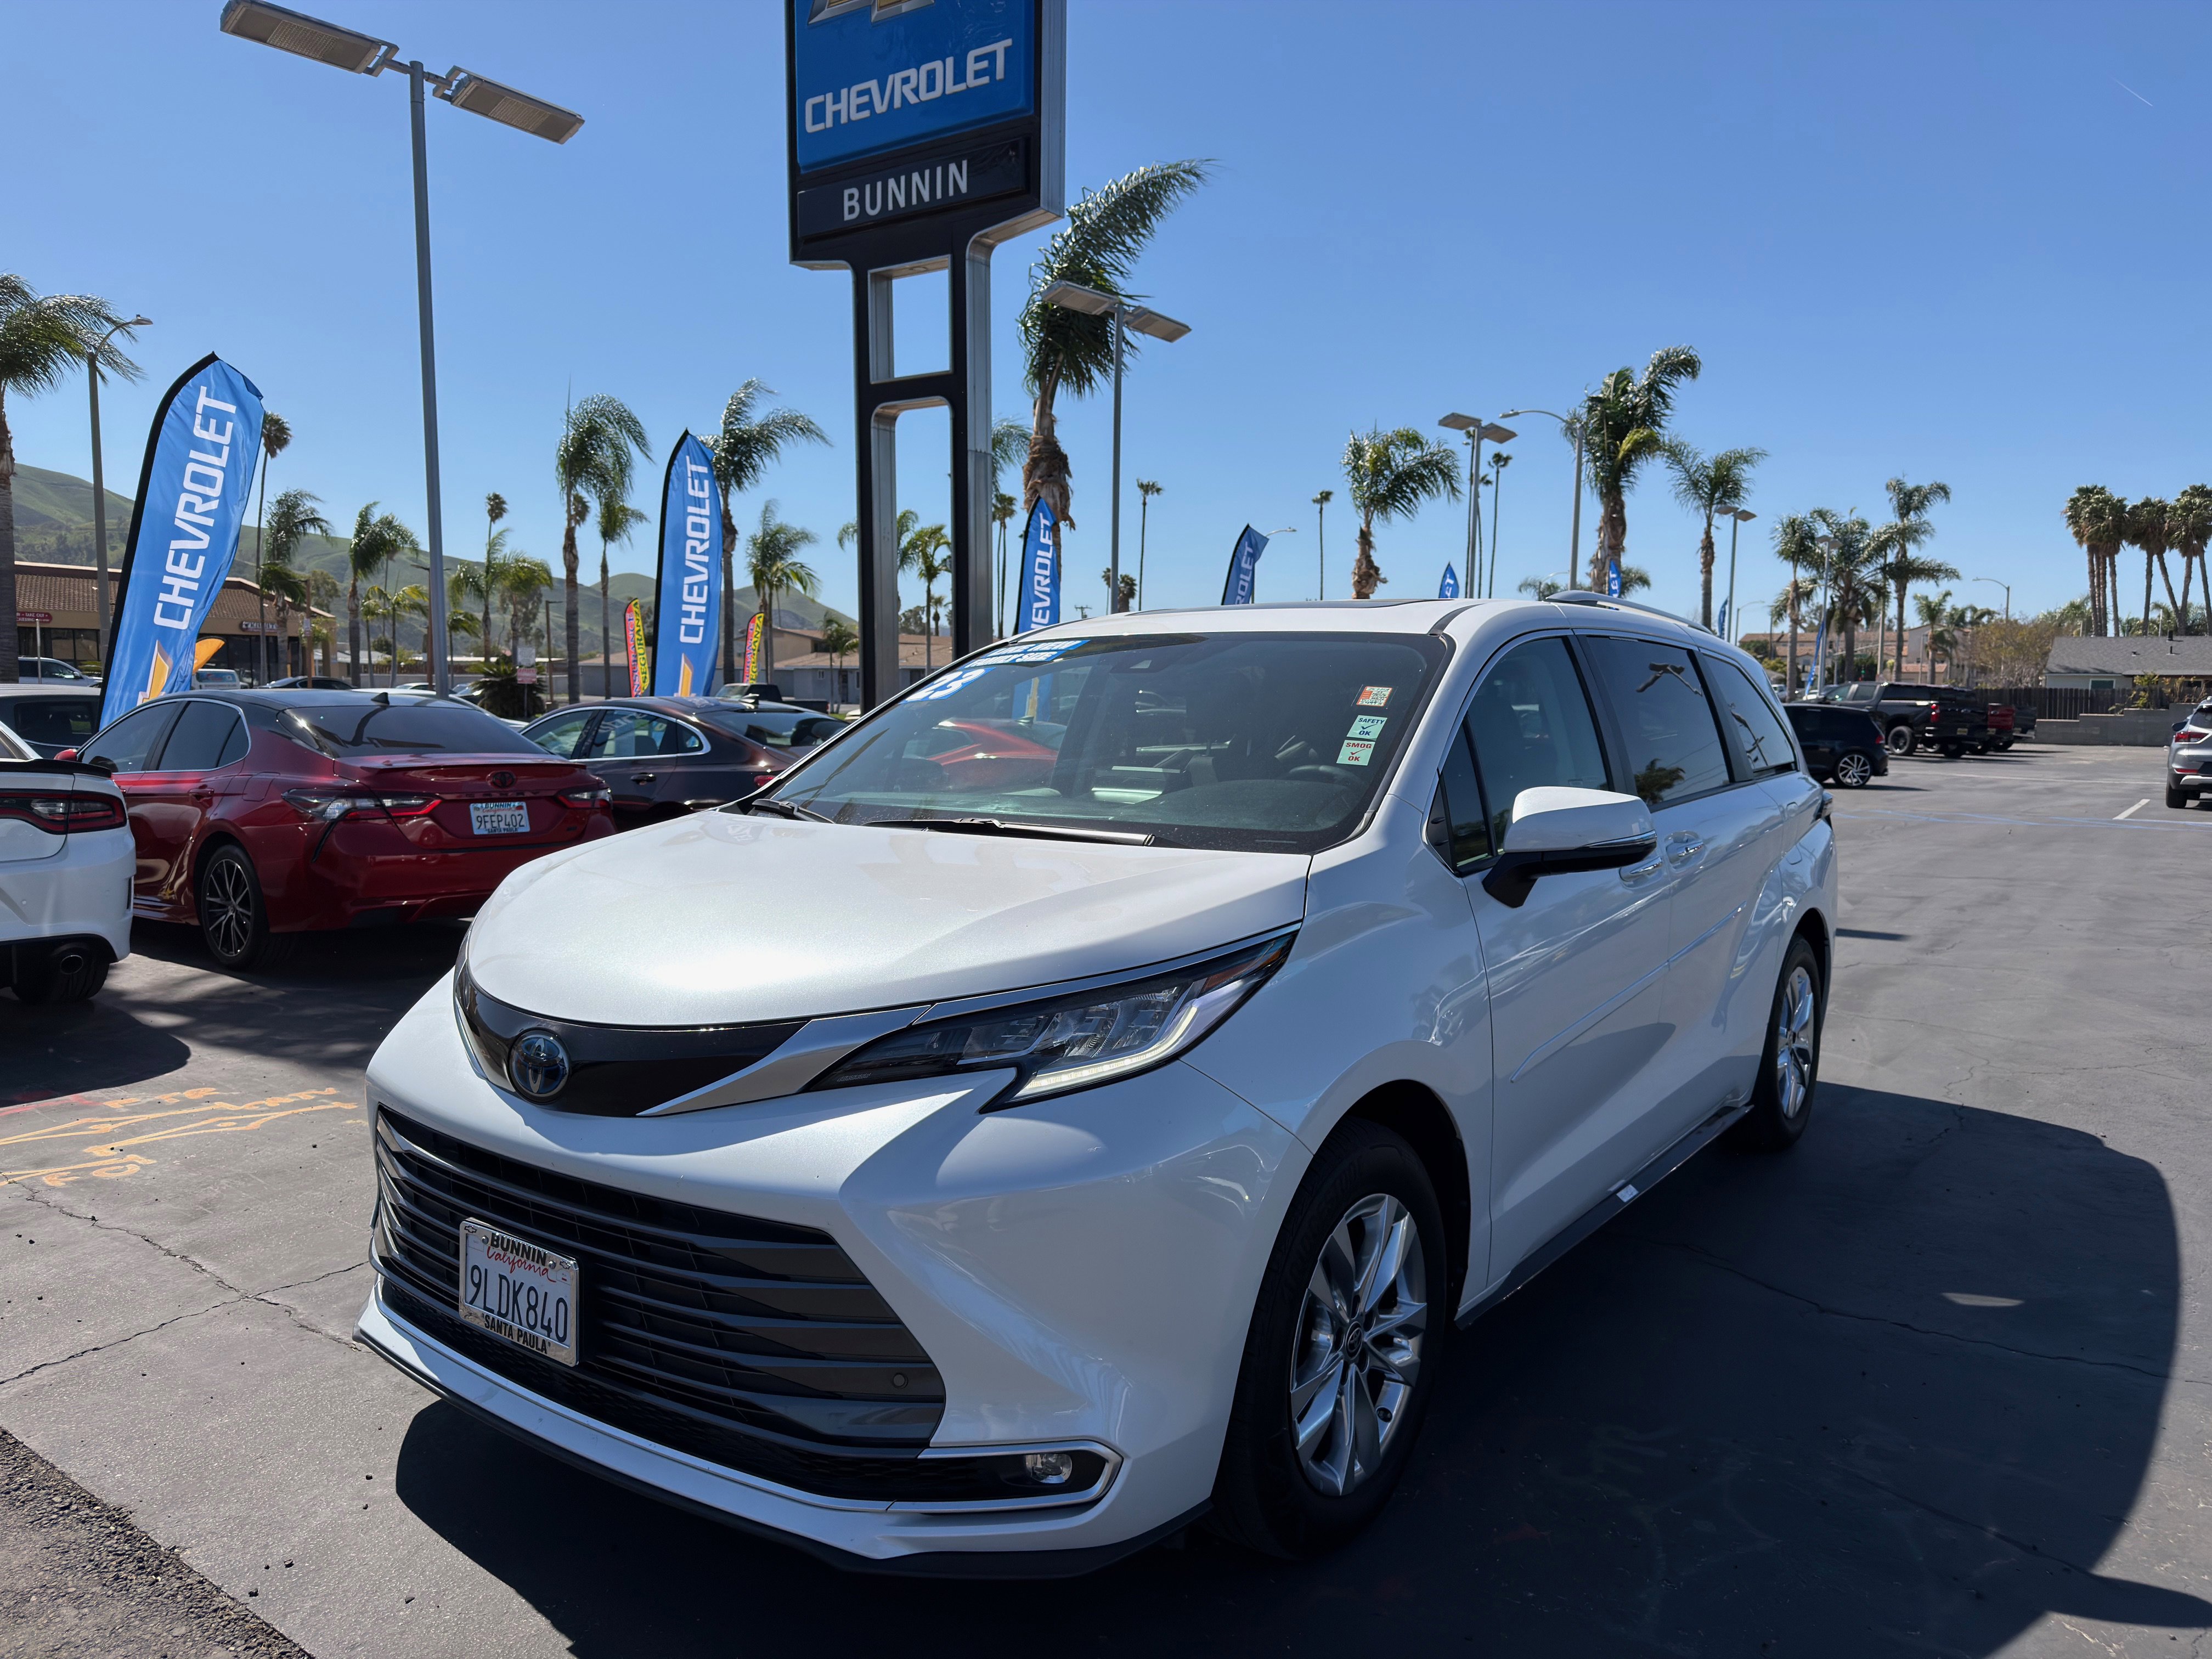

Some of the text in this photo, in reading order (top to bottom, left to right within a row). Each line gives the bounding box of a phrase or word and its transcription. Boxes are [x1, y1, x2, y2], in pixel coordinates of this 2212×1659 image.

[805, 38, 1012, 133] CHEVROLET
[843, 160, 968, 221] BUNNIN
[154, 386, 236, 630] CHEVROLET
[680, 455, 710, 644] CHEVROLET
[1031, 512, 1053, 629] EVROLET
[1235, 541, 1254, 605] ROLET
[1015, 651, 1058, 662] SIZE
[1027, 640, 1083, 651] NEW
[905, 668, 985, 702] 23
[476, 814, 525, 830] 9FEP402
[487, 1245, 557, 1283] California
[490, 1232, 546, 1266] BUNNIN
[469, 1265, 568, 1343] 9LDK840
